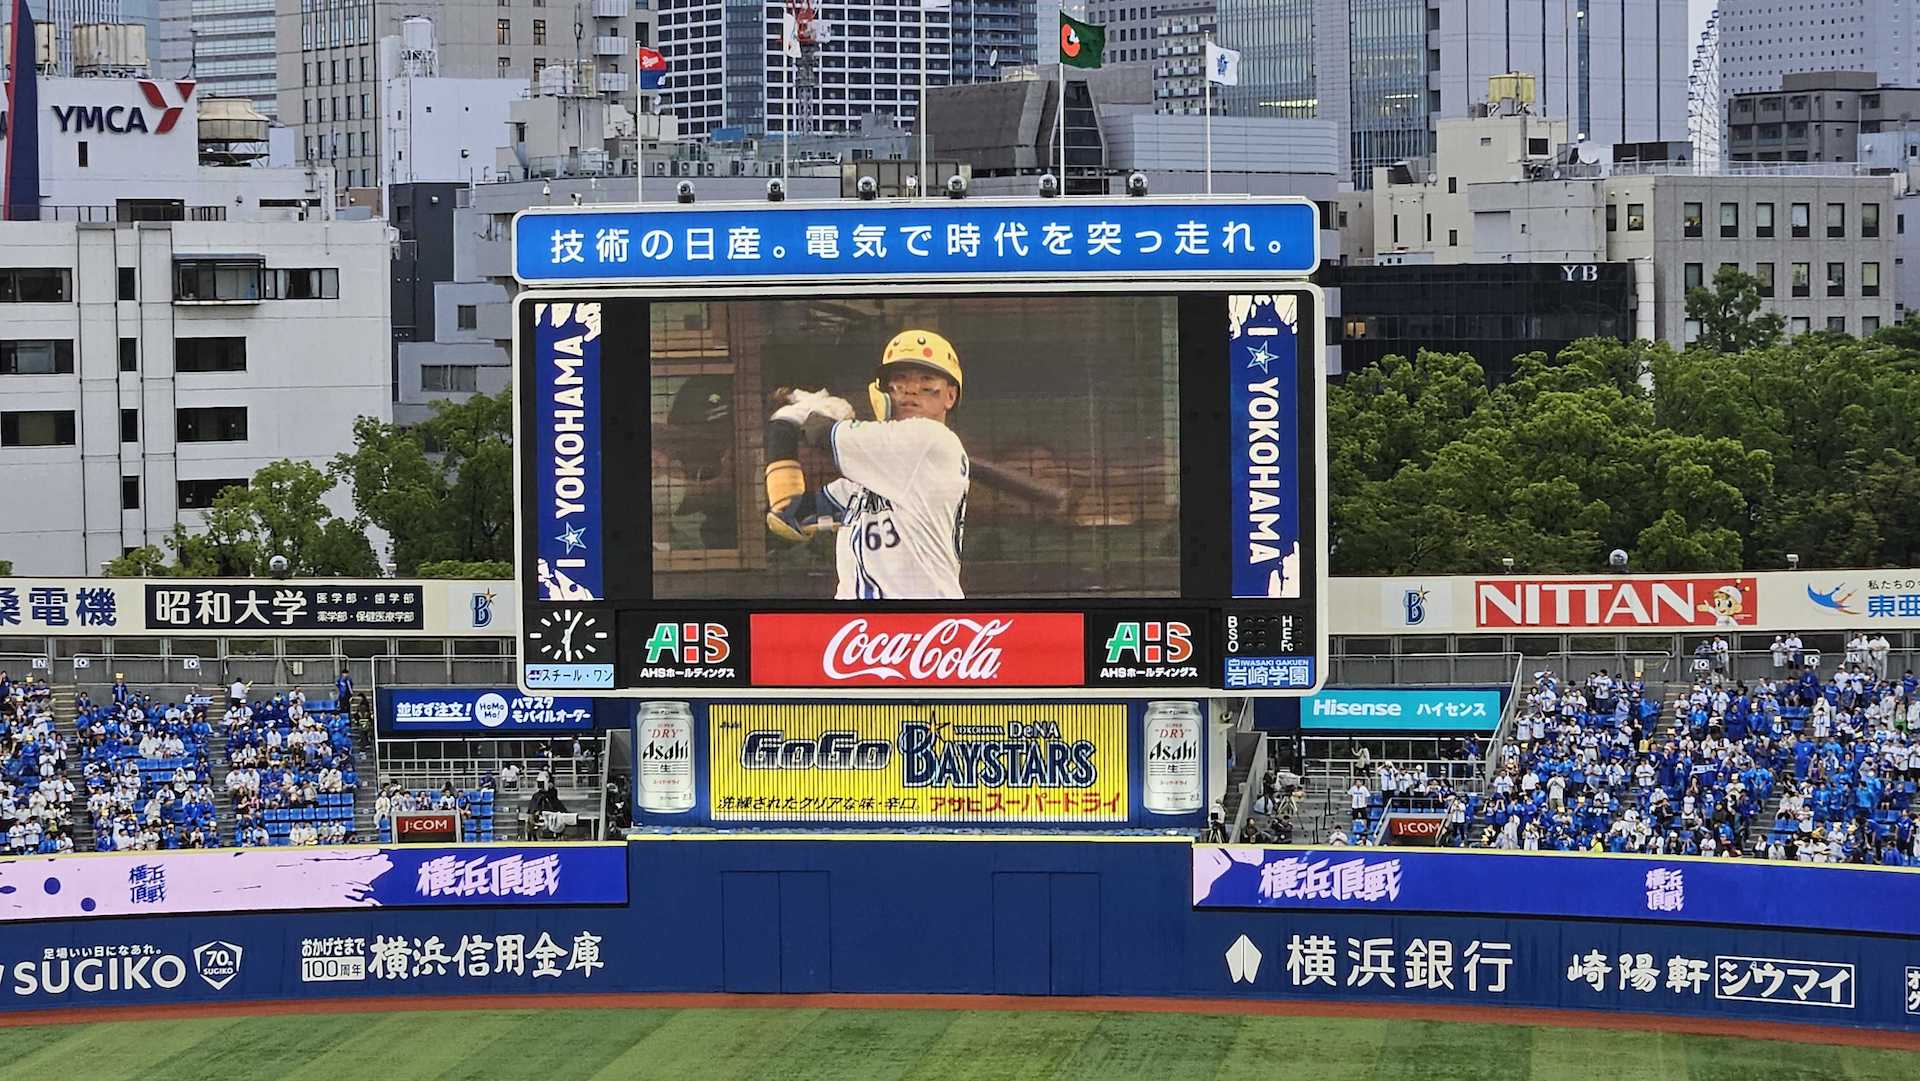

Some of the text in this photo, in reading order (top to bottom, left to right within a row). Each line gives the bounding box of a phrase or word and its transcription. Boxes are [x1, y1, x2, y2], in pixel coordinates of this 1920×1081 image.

[52, 106, 148, 133] YMCA
[551, 221, 1281, 264] 技術の日産。電気で時代を突っ走れ。
[1561, 264, 1598, 281] YB
[553, 335, 585, 519] YOKOHAMA
[1248, 376, 1280, 565] YOKOHAMA
[864, 517, 901, 551] 63
[1868, 579, 1920, 590] 私たちの
[155, 590, 308, 625] 昭和大学
[1479, 583, 1695, 625] NITTAN
[1868, 594, 1920, 618] 東亜
[1227, 616, 1239, 628] B
[1282, 615, 1293, 627] H
[1228, 628, 1239, 640] S
[1282, 627, 1293, 640] E
[822, 618, 1014, 680] Coca-Cola
[640, 667, 735, 678] AHSホールディングス
[1100, 667, 1198, 678] AHSホールディングス
[1227, 666, 1309, 686] 岩崎学園
[511, 697, 554, 709] ハマスタ
[1313, 699, 1402, 716] Hisense
[1416, 702, 1487, 717] ハイセンス
[512, 709, 591, 723] モバイルオーダー
[954, 720, 1060, 738] YOKOHAMA DeNA
[642, 740, 689, 760] Asahi
[1149, 740, 1197, 760] Asahi
[930, 792, 1120, 813] アサヒスーパードライ
[402, 820, 448, 833] J:COM
[1398, 822, 1441, 834] J:COM
[43, 943, 162, 960] 足場いい日になあれ。
[302, 937, 365, 957] おかげさまで
[368, 930, 604, 980] 横浜信用金庫
[203, 967, 234, 975] SUGIKO
[304, 960, 361, 978] 100周年
[1286, 934, 1513, 993] 横浜銀行
[1566, 949, 1712, 994] 崎陽軒
[13, 955, 187, 996] SUGIKO
[1719, 959, 1850, 1003] シウマイ
